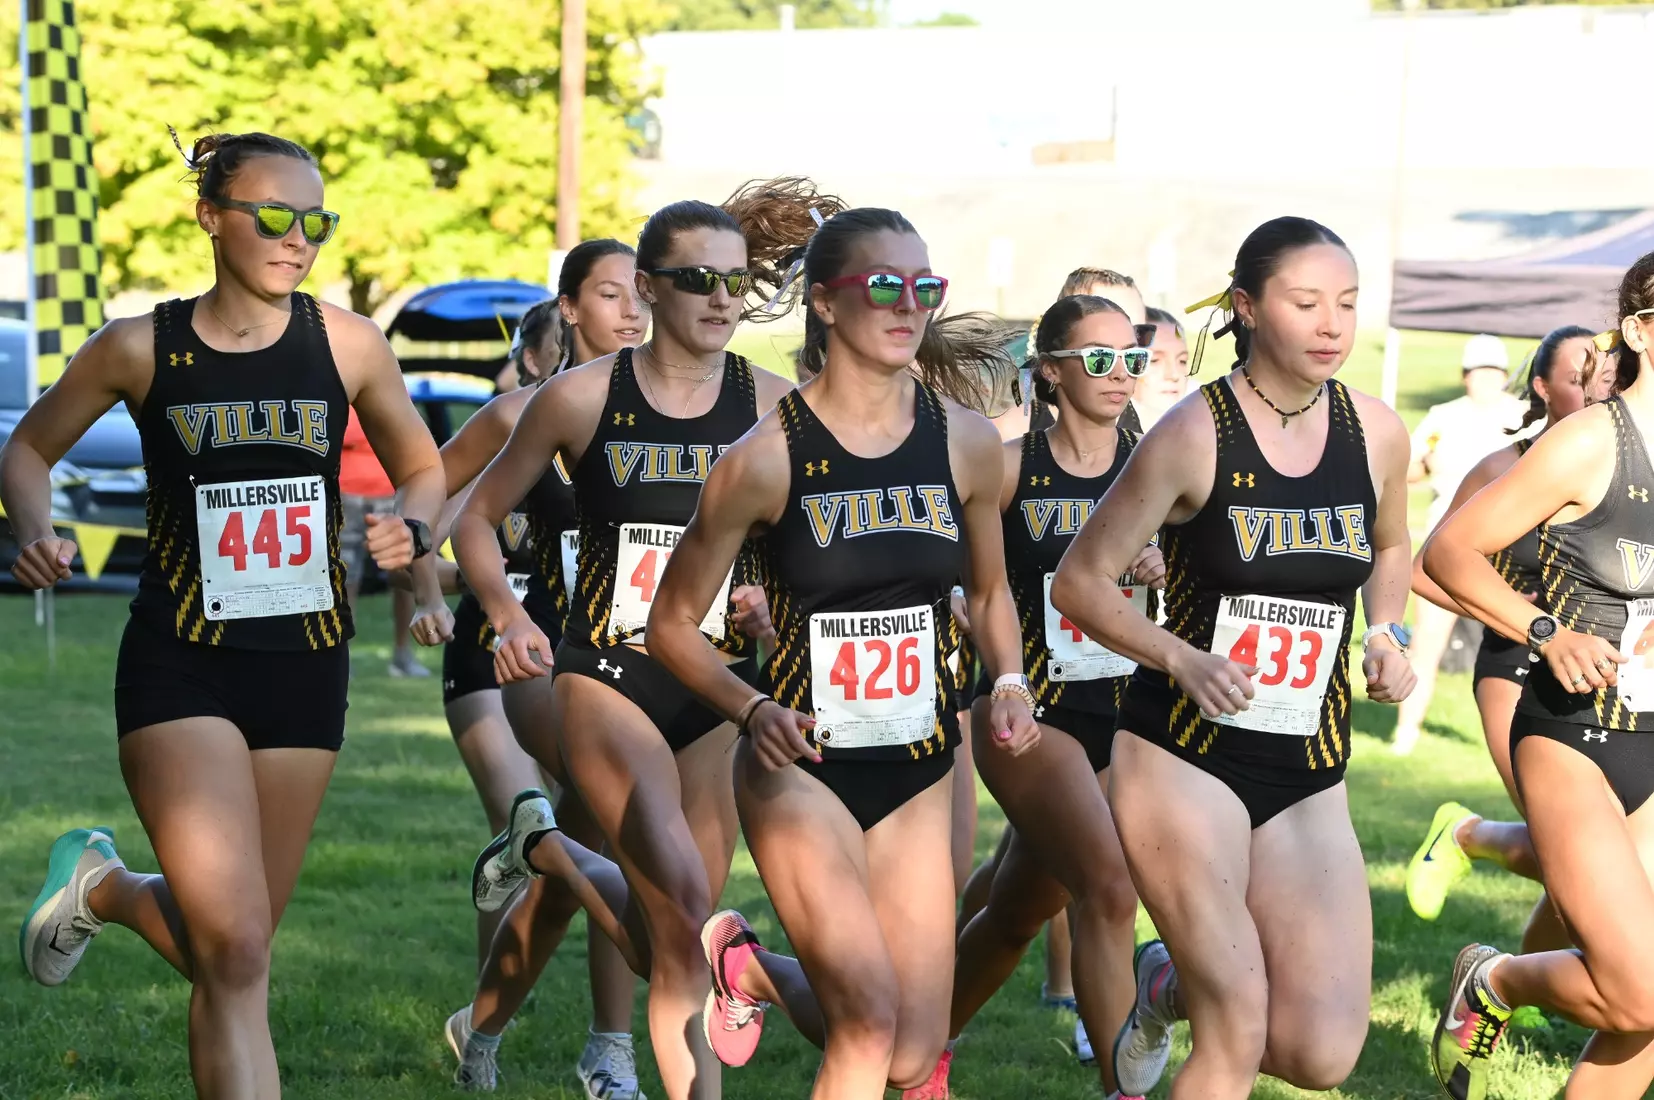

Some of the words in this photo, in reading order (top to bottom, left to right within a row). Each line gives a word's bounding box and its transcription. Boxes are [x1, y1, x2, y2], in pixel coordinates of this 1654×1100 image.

[167, 401, 330, 457] VILLE
[605, 442, 731, 487] VILL
[206, 481, 319, 509] MILLERSVILLE
[801, 485, 959, 548] VILLE
[218, 505, 313, 572] 445
[1228, 503, 1372, 562] VILLE
[820, 611, 927, 638] MILLERSVILLE
[1228, 598, 1337, 630] MILLERSVILLE
[829, 636, 921, 701] 426
[1228, 624, 1323, 689] 433
